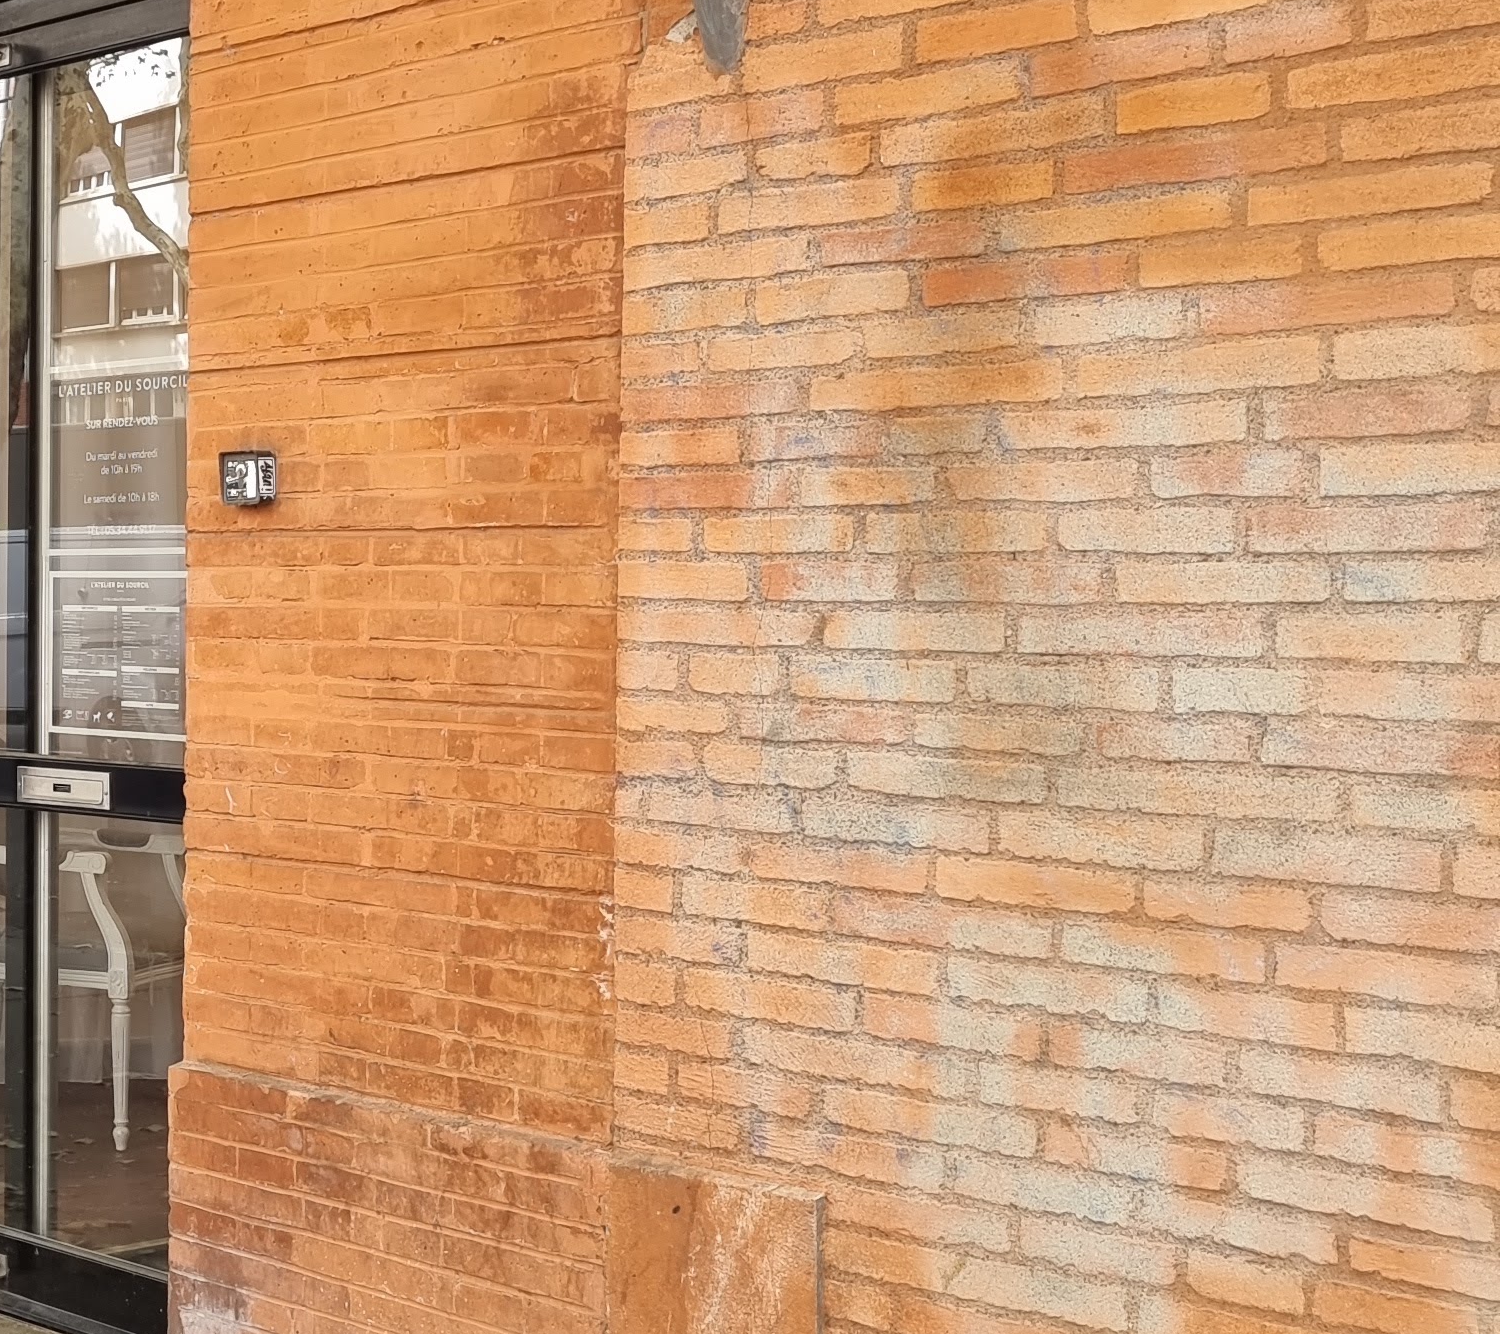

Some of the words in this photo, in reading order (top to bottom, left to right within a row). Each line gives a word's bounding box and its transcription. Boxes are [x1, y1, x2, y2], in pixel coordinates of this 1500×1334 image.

[58, 381, 111, 398] L'ATELIER
[115, 379, 132, 393] DU
[135, 375, 188, 392] SOURCIL
[86, 419, 102, 430] SUR
[102, 415, 159, 429] RENDEZ-VOUS
[85, 451, 96, 462] Du
[117, 452, 127, 460] au
[100, 465, 110, 475] de
[83, 494, 92, 504] Le
[93, 493, 116, 504] samedi
[117, 493, 127, 503] de
